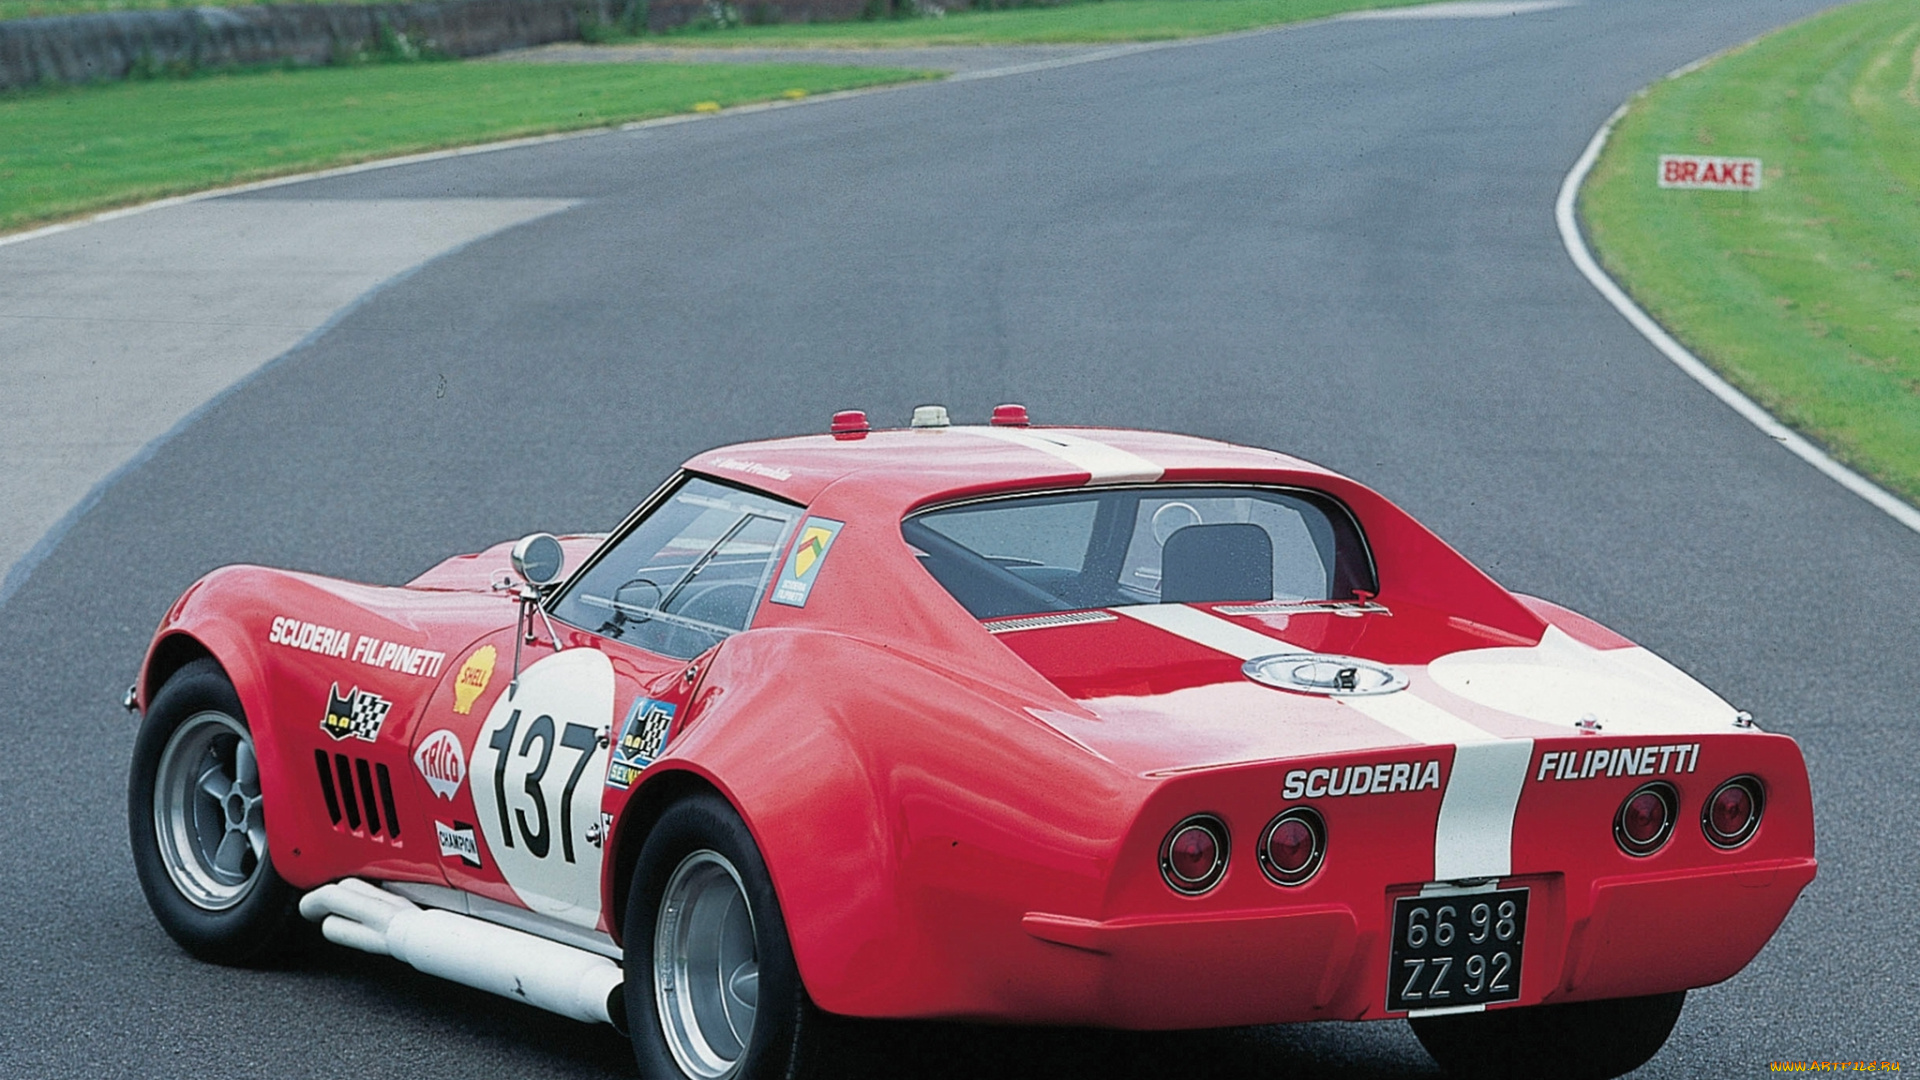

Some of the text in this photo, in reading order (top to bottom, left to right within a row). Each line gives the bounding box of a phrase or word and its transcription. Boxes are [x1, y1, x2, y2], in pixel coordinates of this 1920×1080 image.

[1664, 160, 1755, 187] BRAKE
[268, 615, 447, 679] SCUDERIA FILIPINETTI
[460, 665, 485, 688] SHELL
[420, 735, 460, 784] TRICO
[1282, 743, 1701, 800] SCUDERIA FILIPINETTI
[488, 708, 603, 865] 137
[438, 830, 477, 855] CHAMPION
